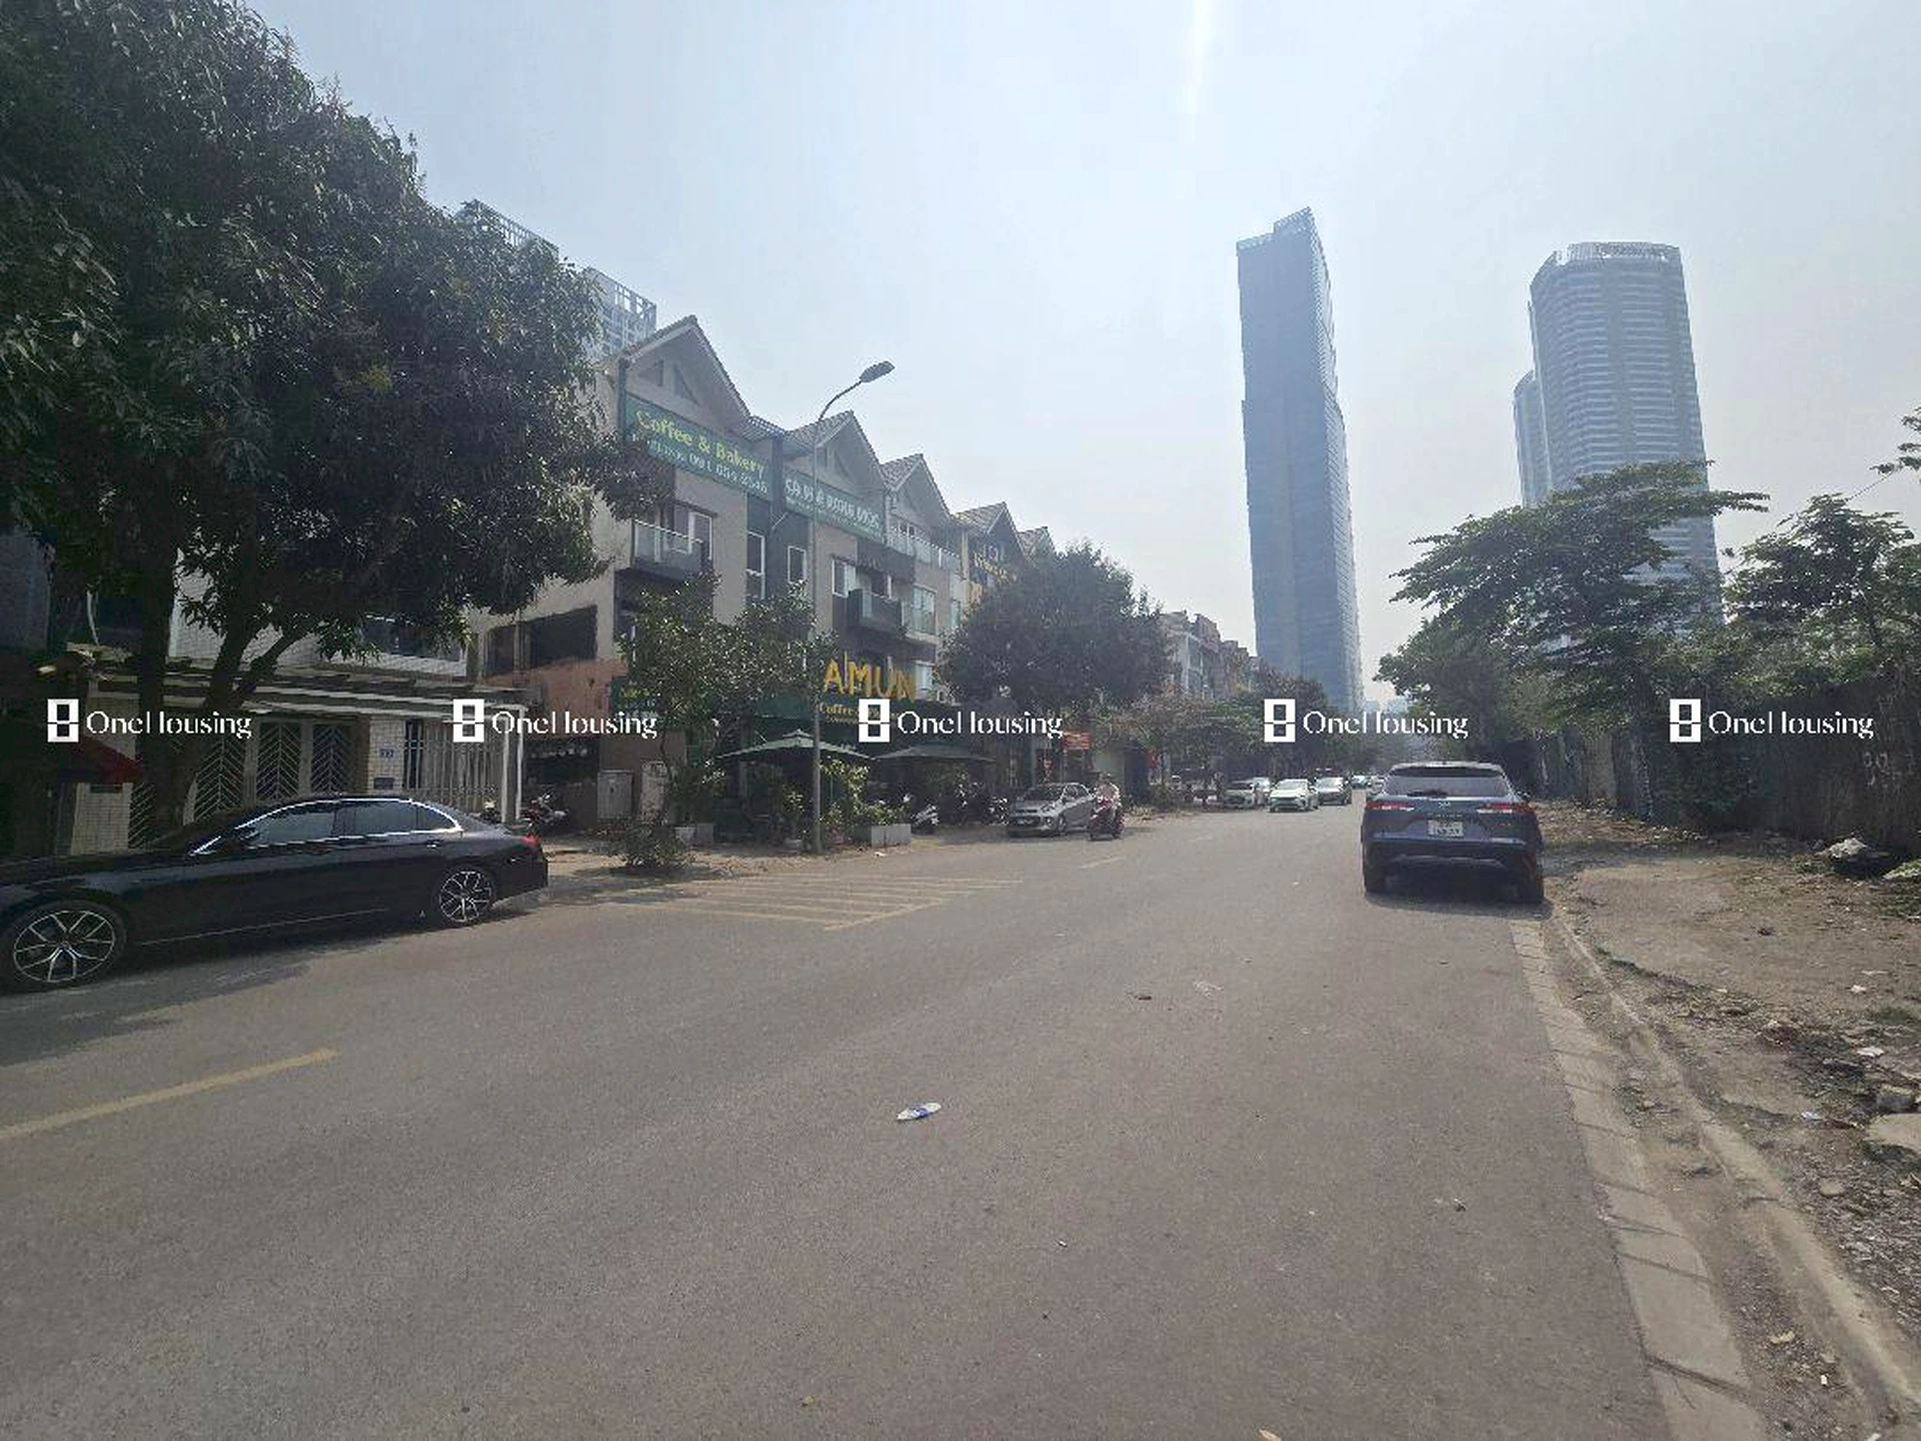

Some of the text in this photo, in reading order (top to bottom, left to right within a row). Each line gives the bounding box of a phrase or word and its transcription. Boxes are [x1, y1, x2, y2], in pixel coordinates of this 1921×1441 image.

[635, 410, 693, 446] Coffee
[698, 435, 711, 454] &
[715, 442, 766, 479] Bakery
[824, 658, 916, 703] AMUN
